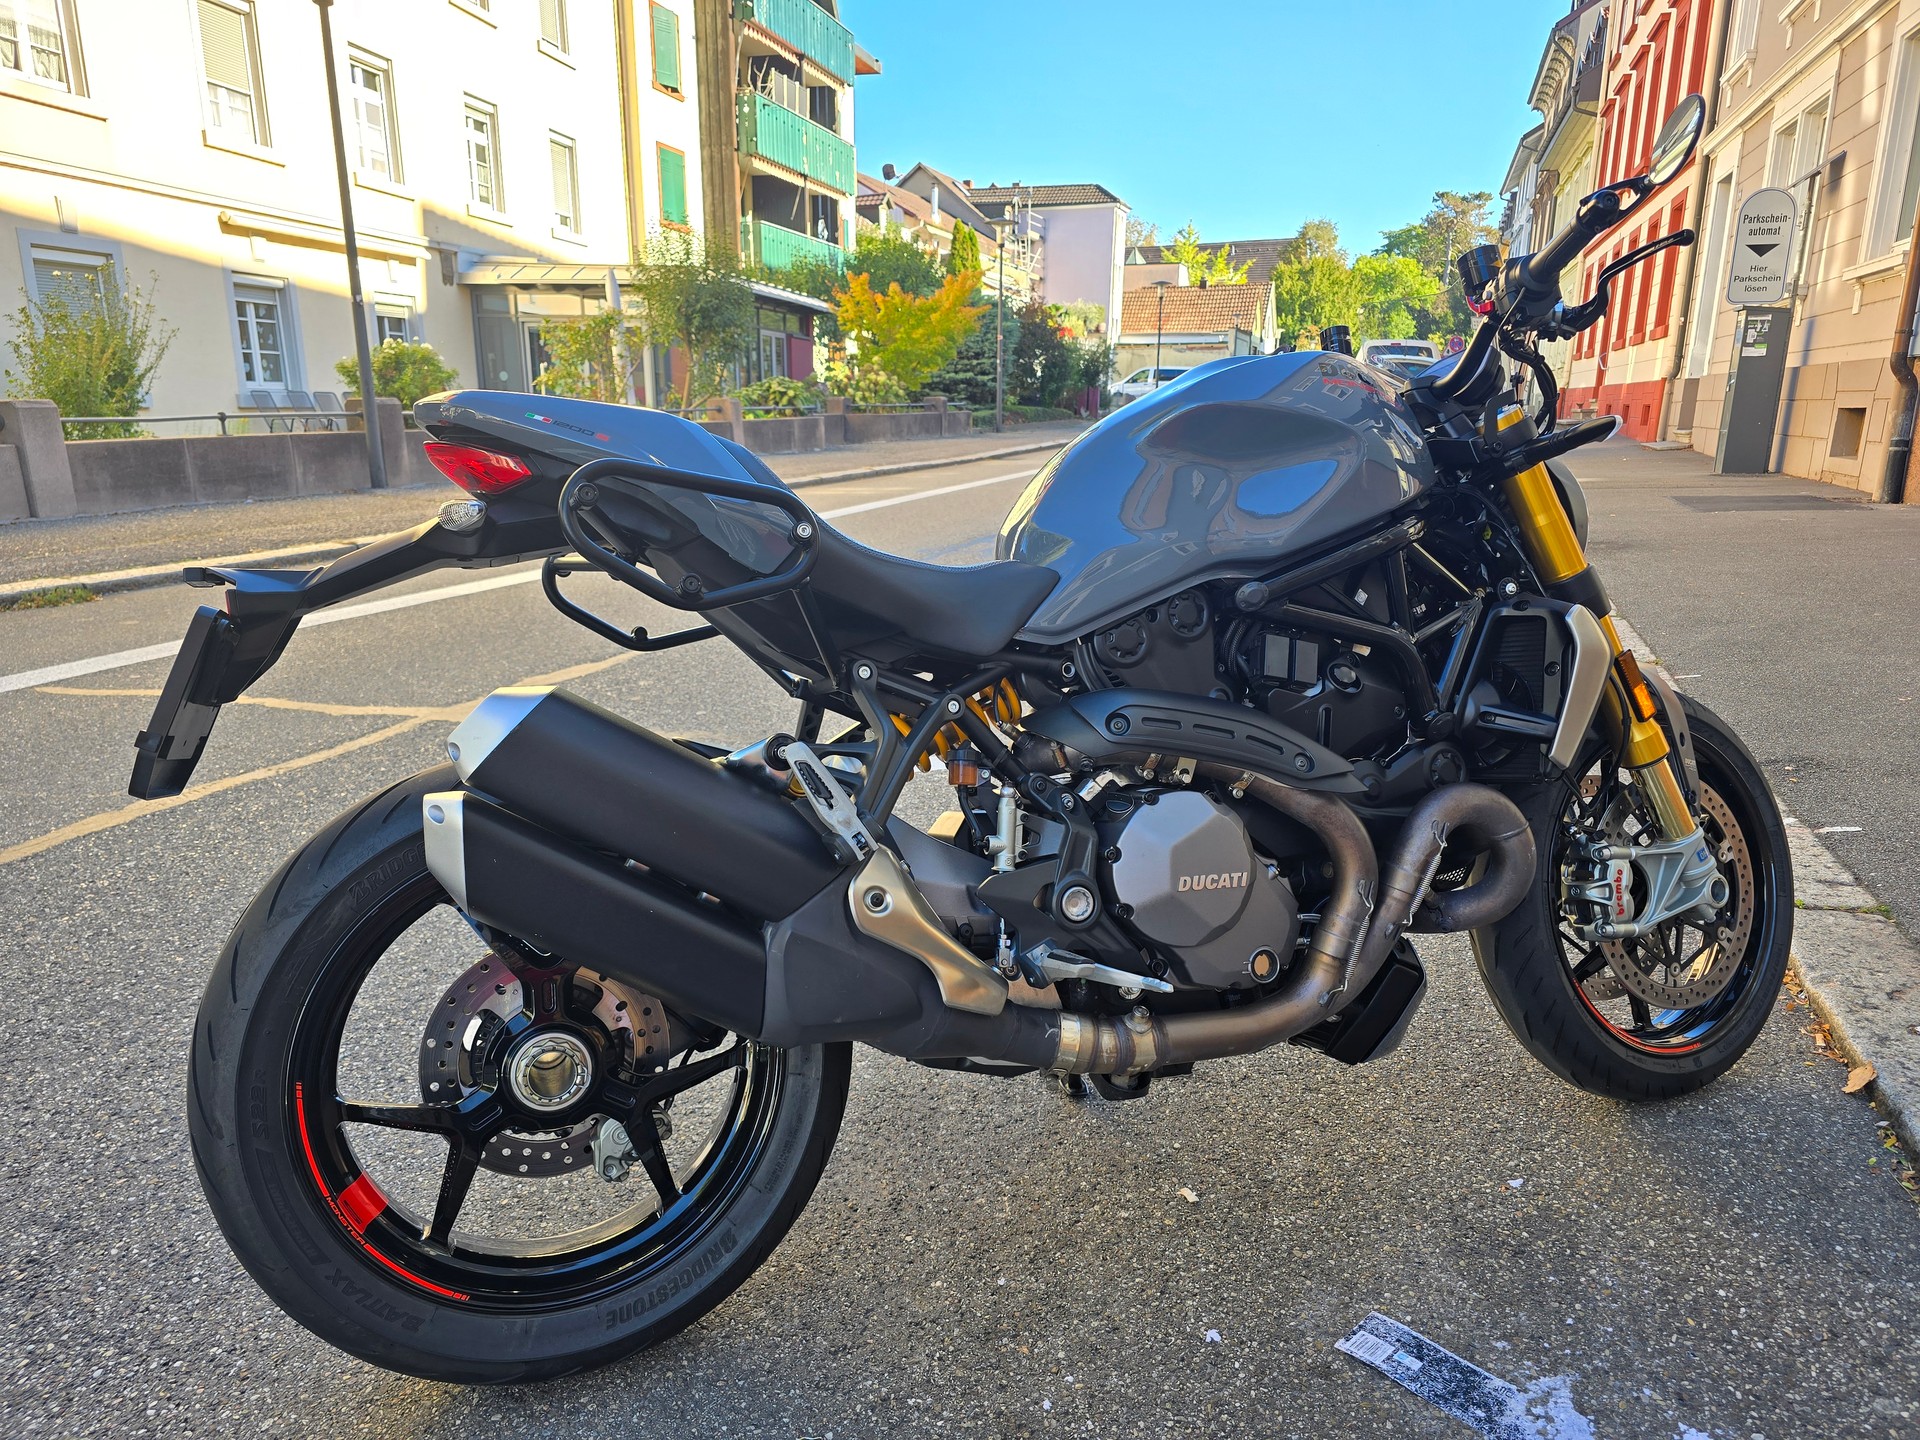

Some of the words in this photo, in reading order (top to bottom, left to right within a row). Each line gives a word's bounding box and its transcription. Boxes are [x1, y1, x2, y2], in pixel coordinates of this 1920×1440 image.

[1742, 213, 1791, 224] Parkschein-
[1748, 226, 1781, 236] automat
[1749, 264, 1768, 272] Hier
[1733, 274, 1782, 283] Parkschein
[1744, 284, 1768, 292] lösen
[1177, 871, 1248, 892] DUCATI
[1613, 868, 1625, 917] brembo
[326, 1196, 366, 1245] MONSTER
[605, 1227, 739, 1330] BRIDGESTONE
